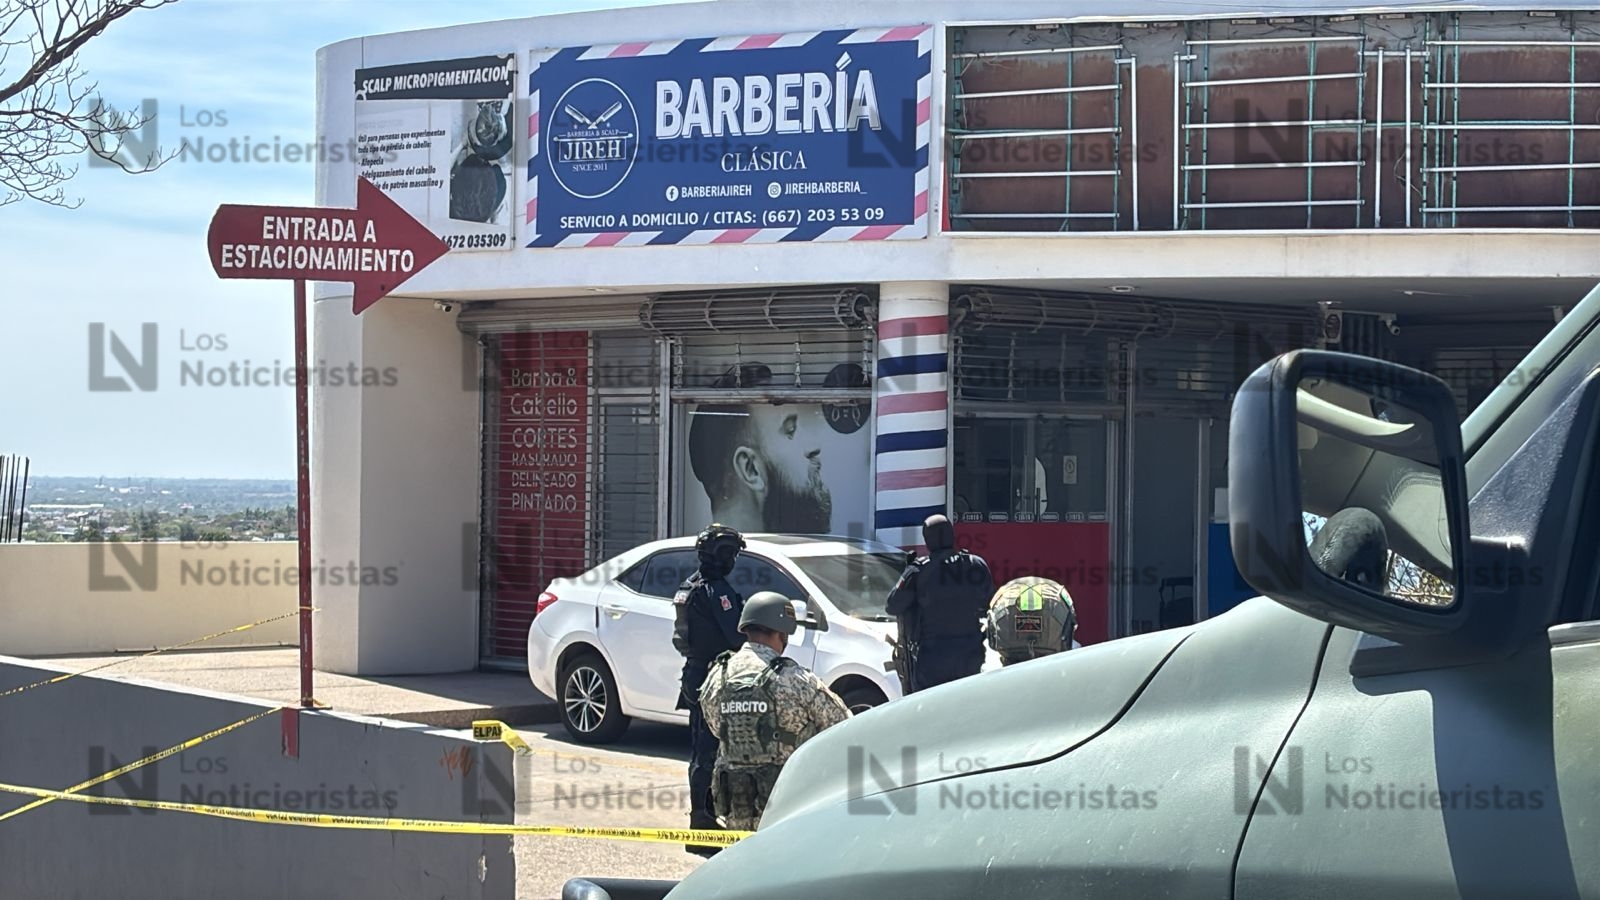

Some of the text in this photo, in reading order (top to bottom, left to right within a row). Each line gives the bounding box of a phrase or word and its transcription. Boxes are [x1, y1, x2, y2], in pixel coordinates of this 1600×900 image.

[362, 65, 508, 94] SCALP MICROPIGMENTACION
[655, 50, 882, 140] BARBERÍA
[411, 129, 446, 140] experimentan
[564, 139, 622, 160] JIREH
[720, 146, 807, 173] CLÁSICA
[361, 156, 384, 168] Alopecia
[405, 166, 415, 175] del
[416, 165, 436, 175] cabello
[572, 163, 608, 172] SINCE 2011
[409, 178, 438, 187] masculino
[681, 184, 752, 199] BARBERIAJIREH
[784, 181, 867, 196] JIREHBARBERIA_
[560, 215, 615, 229] SERVICIO
[619, 215, 628, 227] A
[632, 212, 699, 227] DOMICILIO
[713, 211, 757, 225] CITAS:
[762, 209, 802, 226] (667)
[807, 208, 835, 222] 203
[841, 207, 860, 221] 53
[864, 207, 885, 221] 09
[262, 216, 377, 243] ENTRADA A
[467, 233, 507, 248] 035309
[221, 244, 414, 272] ESTACIONAMIENTO
[566, 367, 577, 387] &
[510, 392, 578, 415] Cabello
[512, 427, 577, 449] CORTES
[512, 471, 577, 488] DELINEADO
[511, 493, 577, 513] PINTADO
[720, 699, 767, 714] EJÉRCITO
